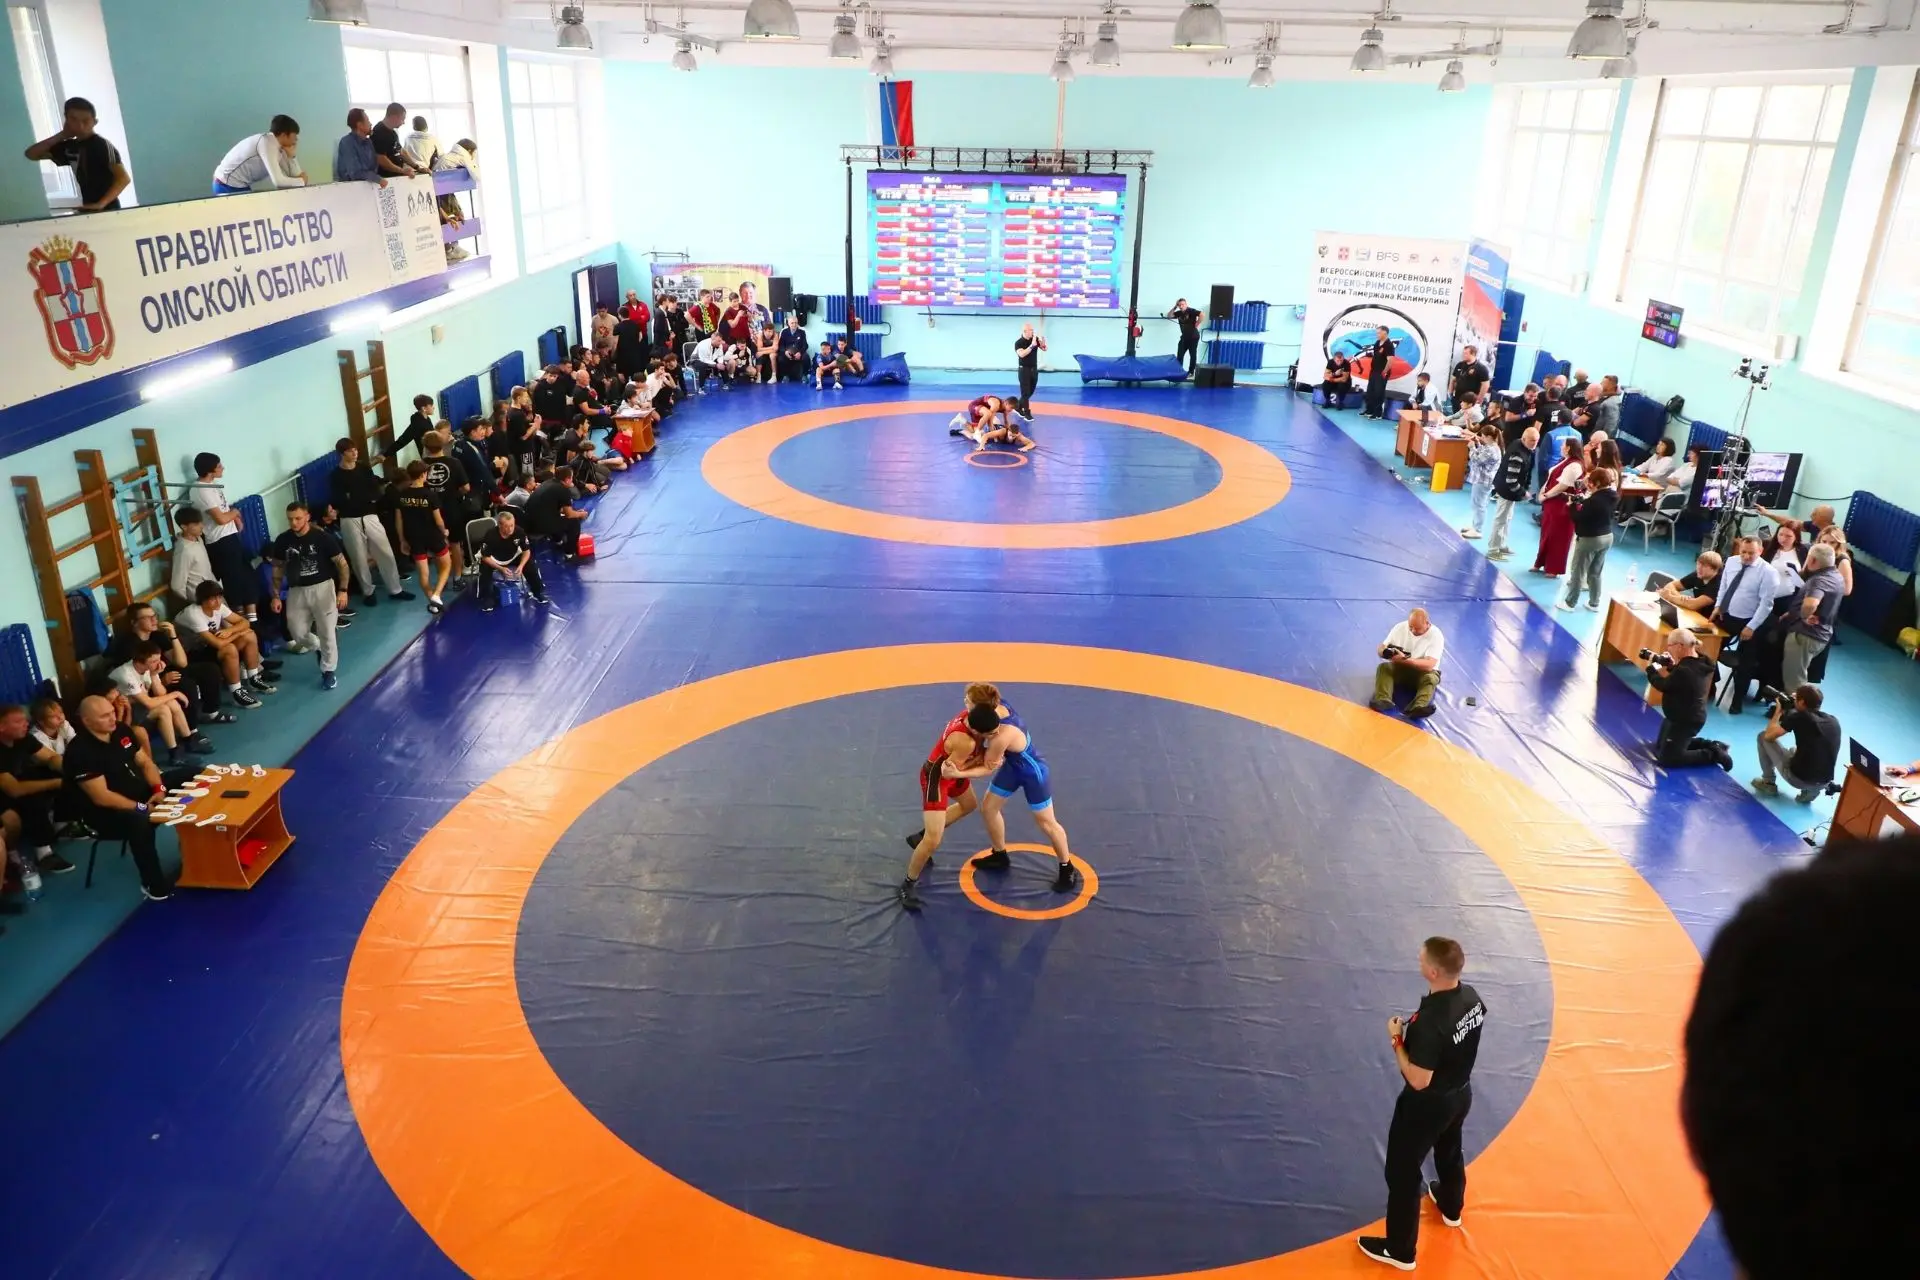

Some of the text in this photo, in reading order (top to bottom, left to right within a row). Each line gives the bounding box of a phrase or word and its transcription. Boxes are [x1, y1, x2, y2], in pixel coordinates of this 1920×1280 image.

[136, 209, 333, 277] ПРАВИТЕЛЬСТВО
[1376, 251, 1400, 262] BFS
[1320, 267, 1453, 285] ВСЕРОССИЙСКИЕ СОРЕВНОВАНИЯ
[140, 251, 348, 334] ОМСКОЙ ОБЛАСТИ
[1318, 276, 1451, 297] ПО ГРЕКО-РИМСКОЙ БОРЬБЕ
[1317, 287, 1346, 295] памяти
[1396, 292, 1450, 306] Калимулина
[1330, 393, 1337, 404] 2
